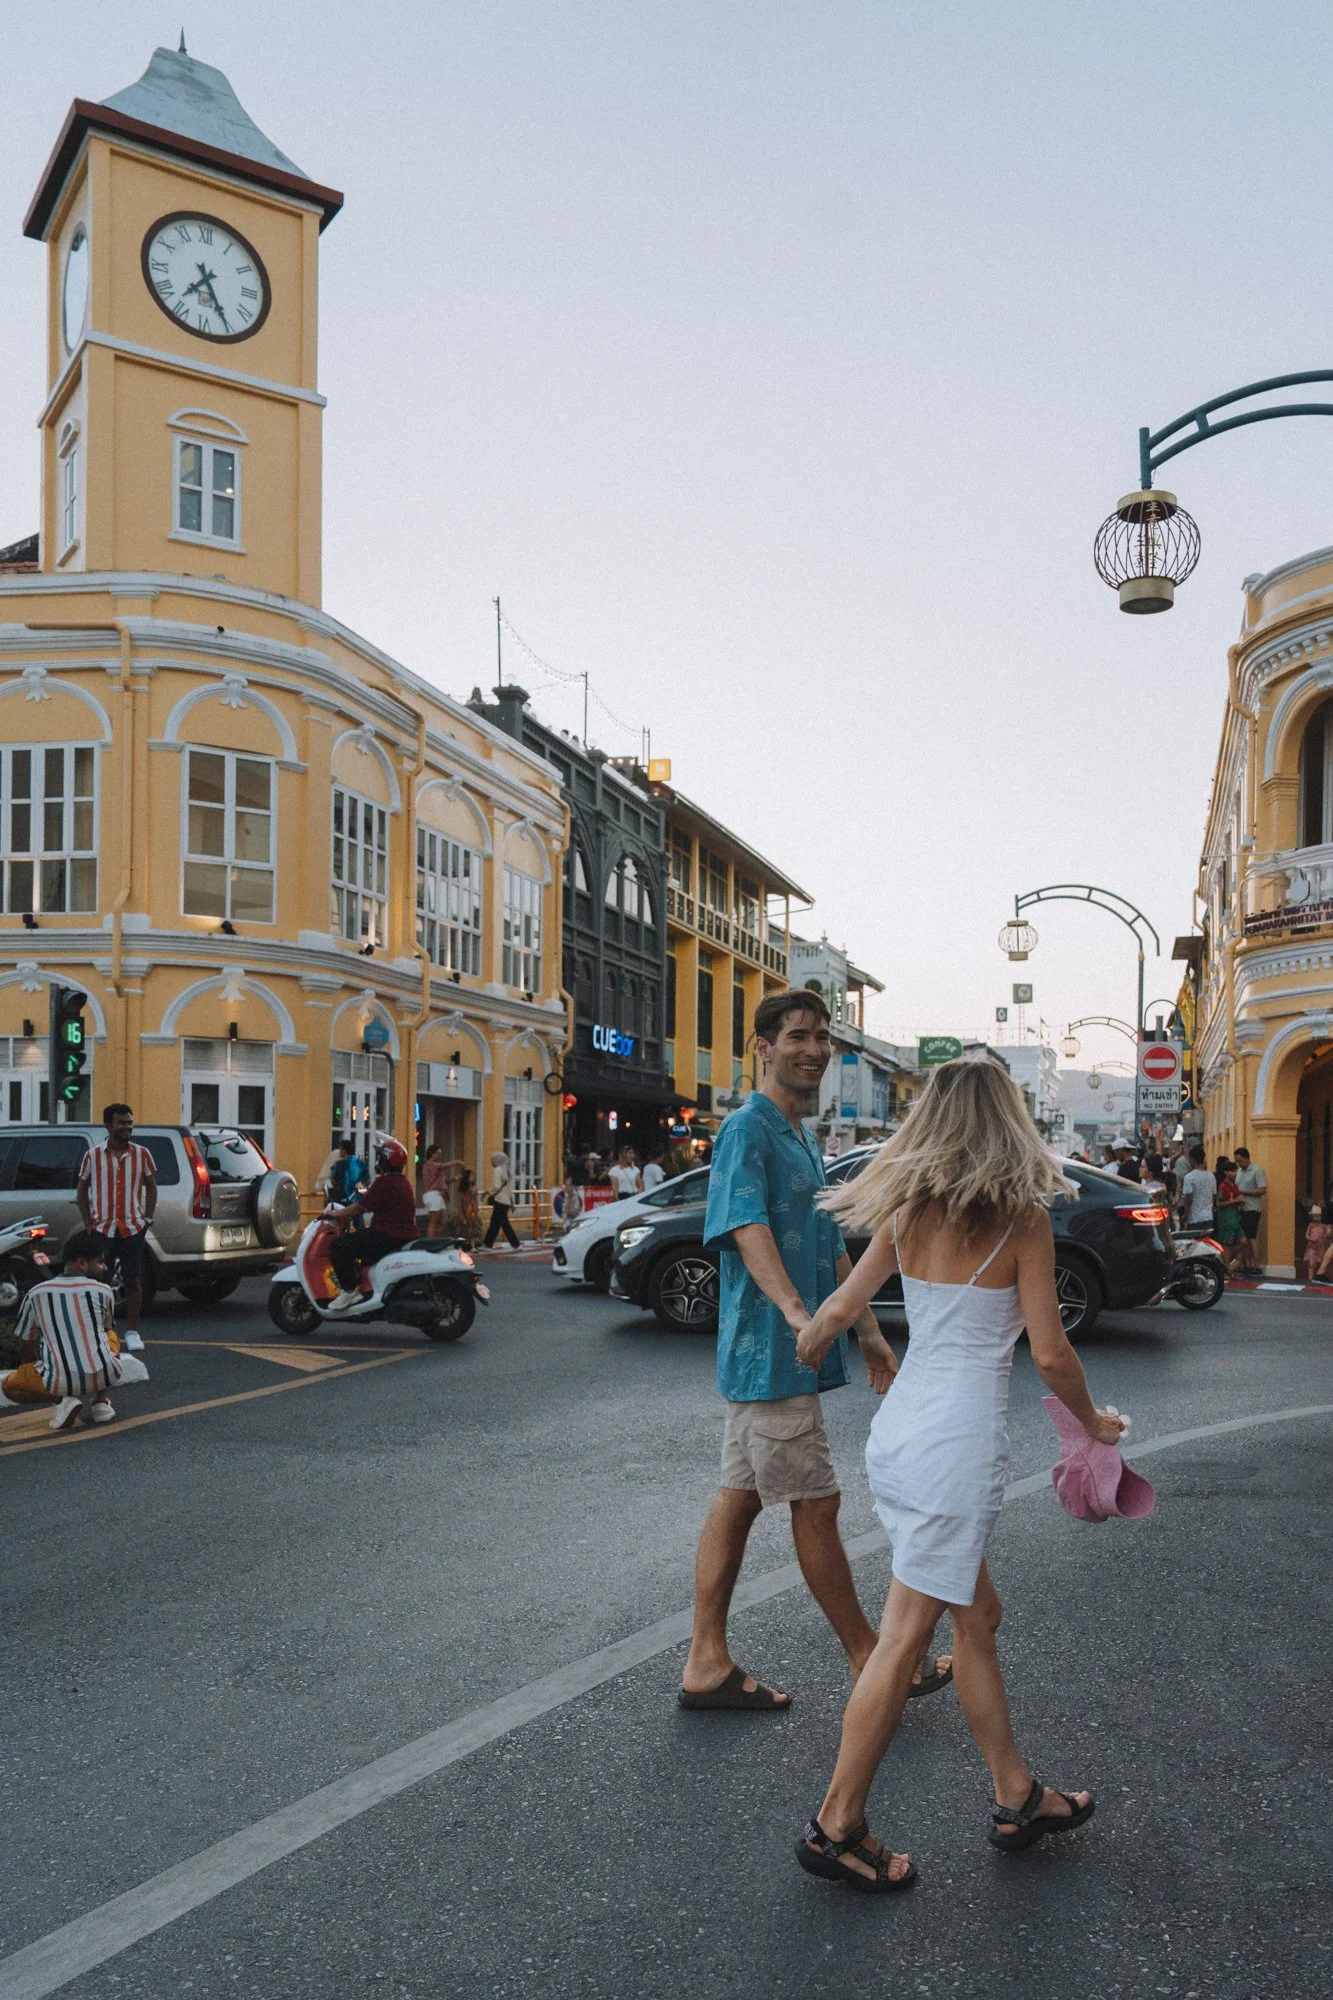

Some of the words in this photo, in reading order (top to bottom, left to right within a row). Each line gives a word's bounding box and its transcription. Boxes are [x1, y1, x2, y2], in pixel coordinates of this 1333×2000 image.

[198, 225, 213, 246] XII
[67, 1022, 81, 1044] 16
[1141, 1087, 1178, 1100] ห้ามเข้า
